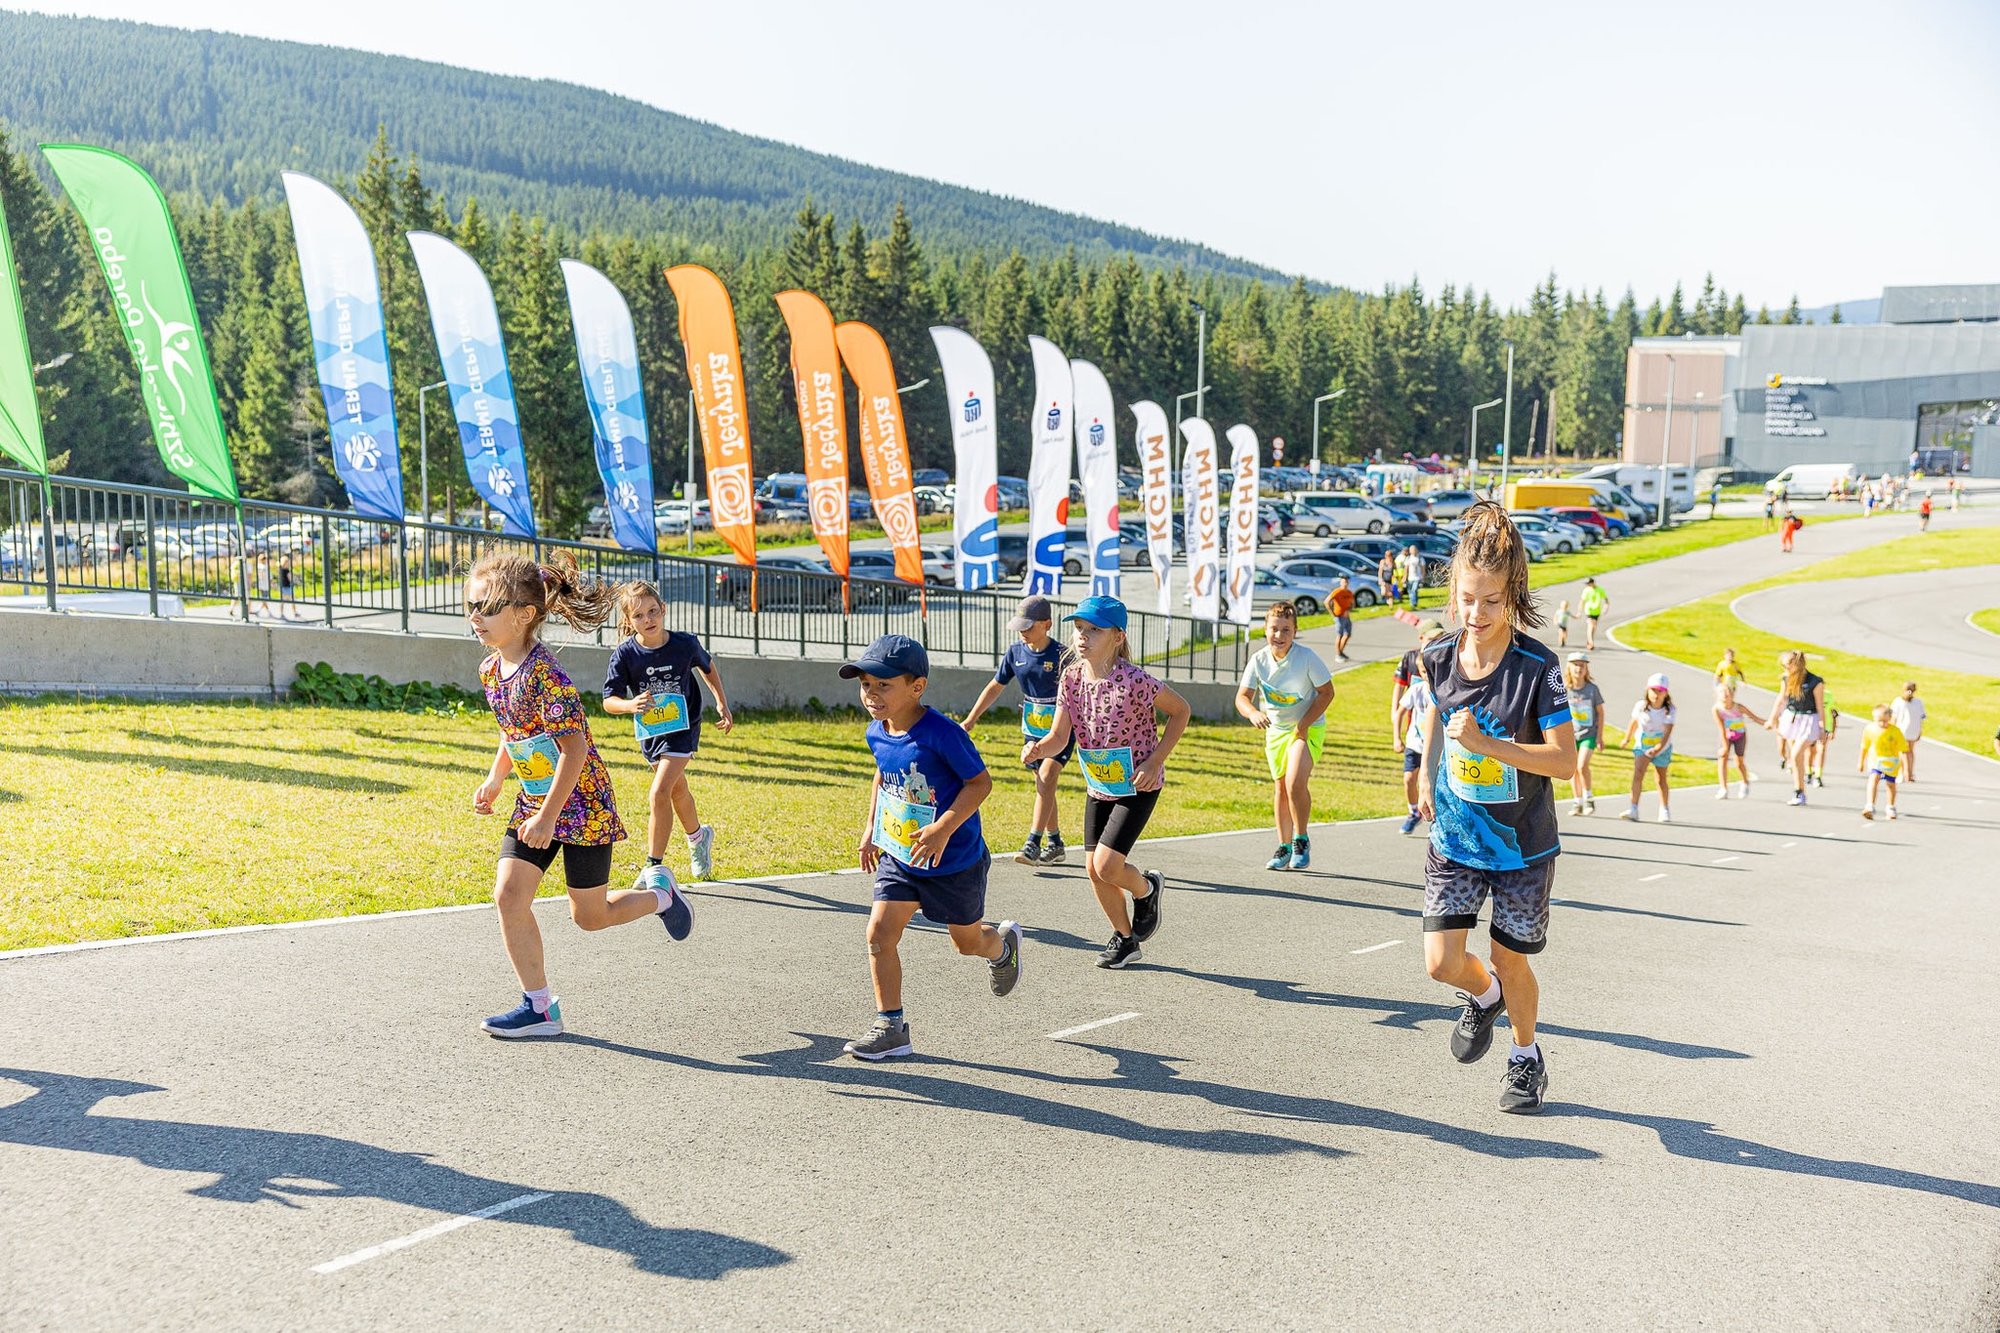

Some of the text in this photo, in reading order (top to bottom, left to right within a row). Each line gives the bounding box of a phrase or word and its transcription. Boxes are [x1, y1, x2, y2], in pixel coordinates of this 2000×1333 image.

[653, 707, 665, 719] 99
[1095, 765, 1111, 778] 24
[1459, 760, 1481, 778] 70
